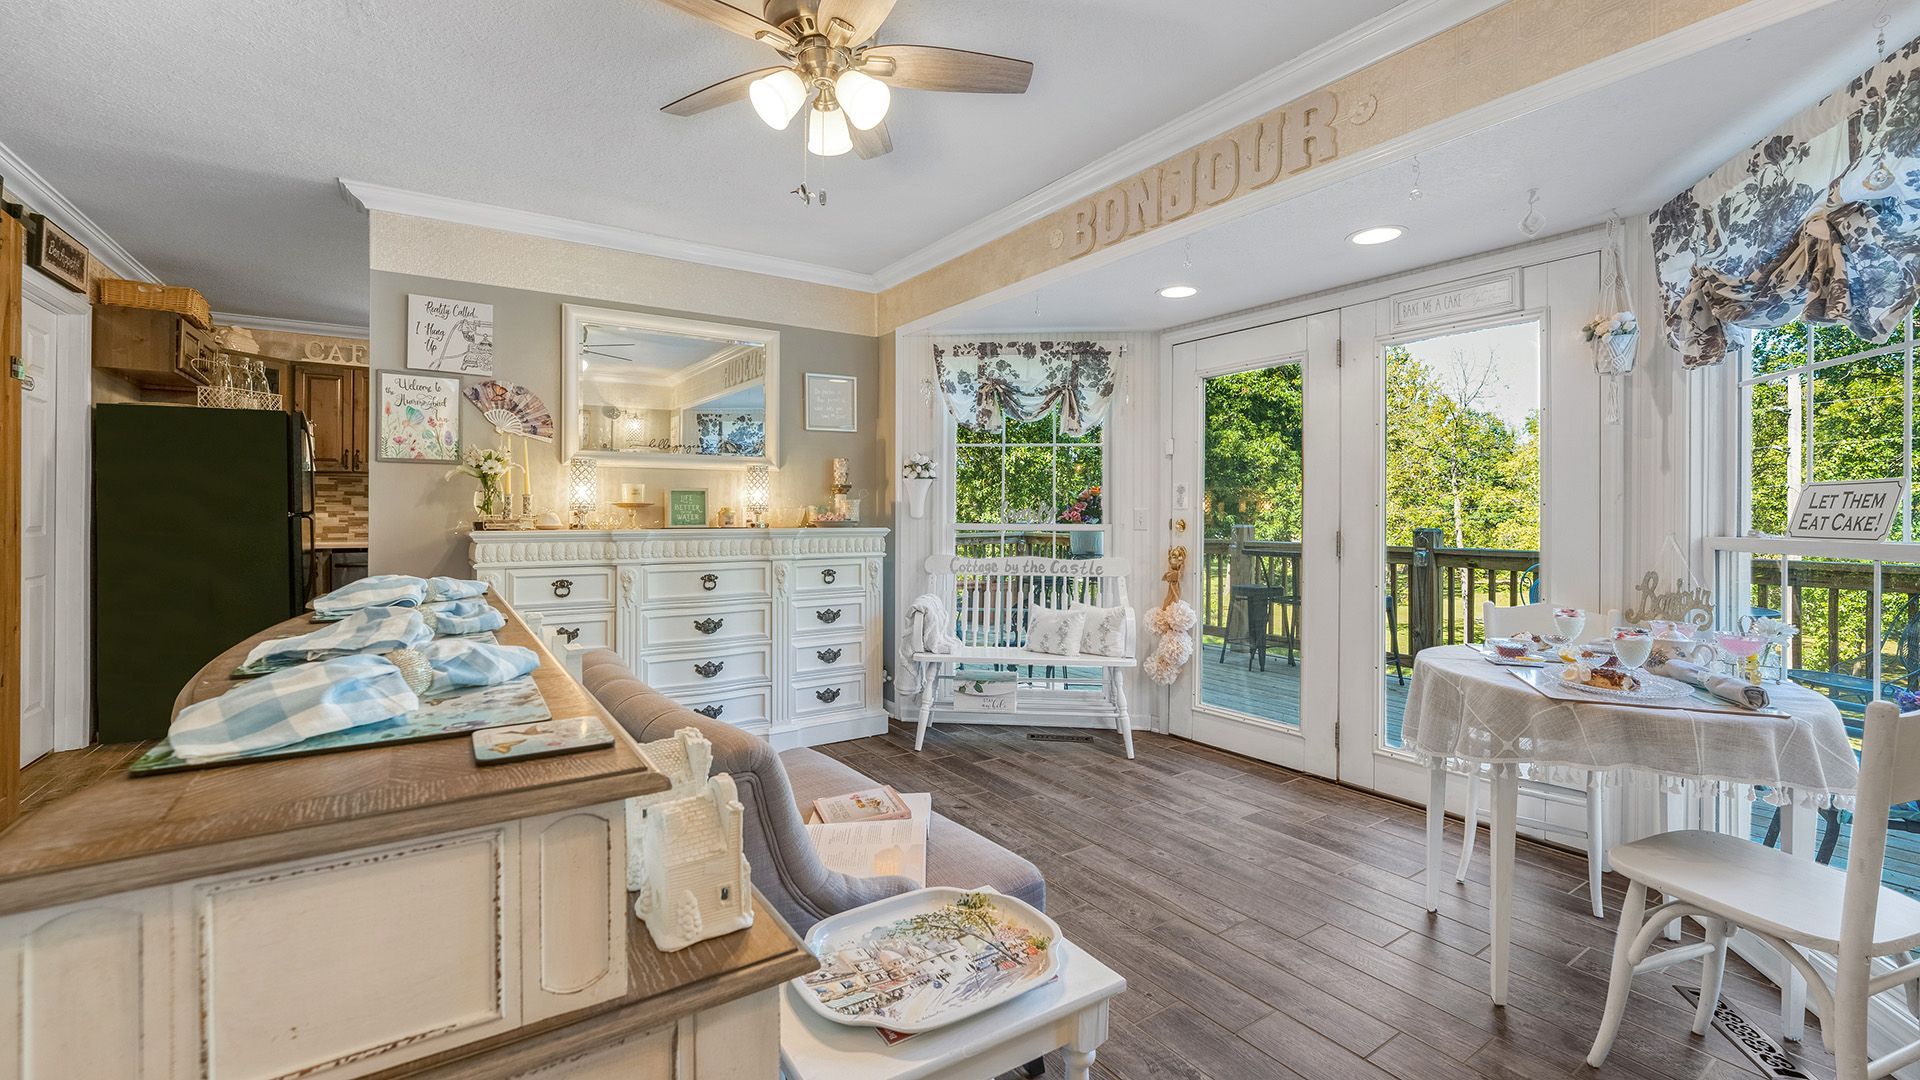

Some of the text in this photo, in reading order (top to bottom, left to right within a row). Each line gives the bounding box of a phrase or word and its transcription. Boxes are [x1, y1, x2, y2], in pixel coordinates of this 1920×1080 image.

[1068, 90, 1339, 260] BONJOUR
[425, 301, 450, 320] Reality
[1403, 303, 1419, 318] BAKE
[1423, 300, 1432, 313] ME
[1435, 299, 1442, 311] A
[1444, 294, 1462, 310] CAKE
[416, 321, 446, 342] I Hung
[424, 339, 437, 356] Up
[394, 378, 442, 393] Welcome to
[649, 438, 671, 449] hello
[1808, 491, 1887, 509] LET THEM
[1798, 512, 1883, 532] EAT CAKE!
[950, 556, 1104, 576] Cottage by the Castle
